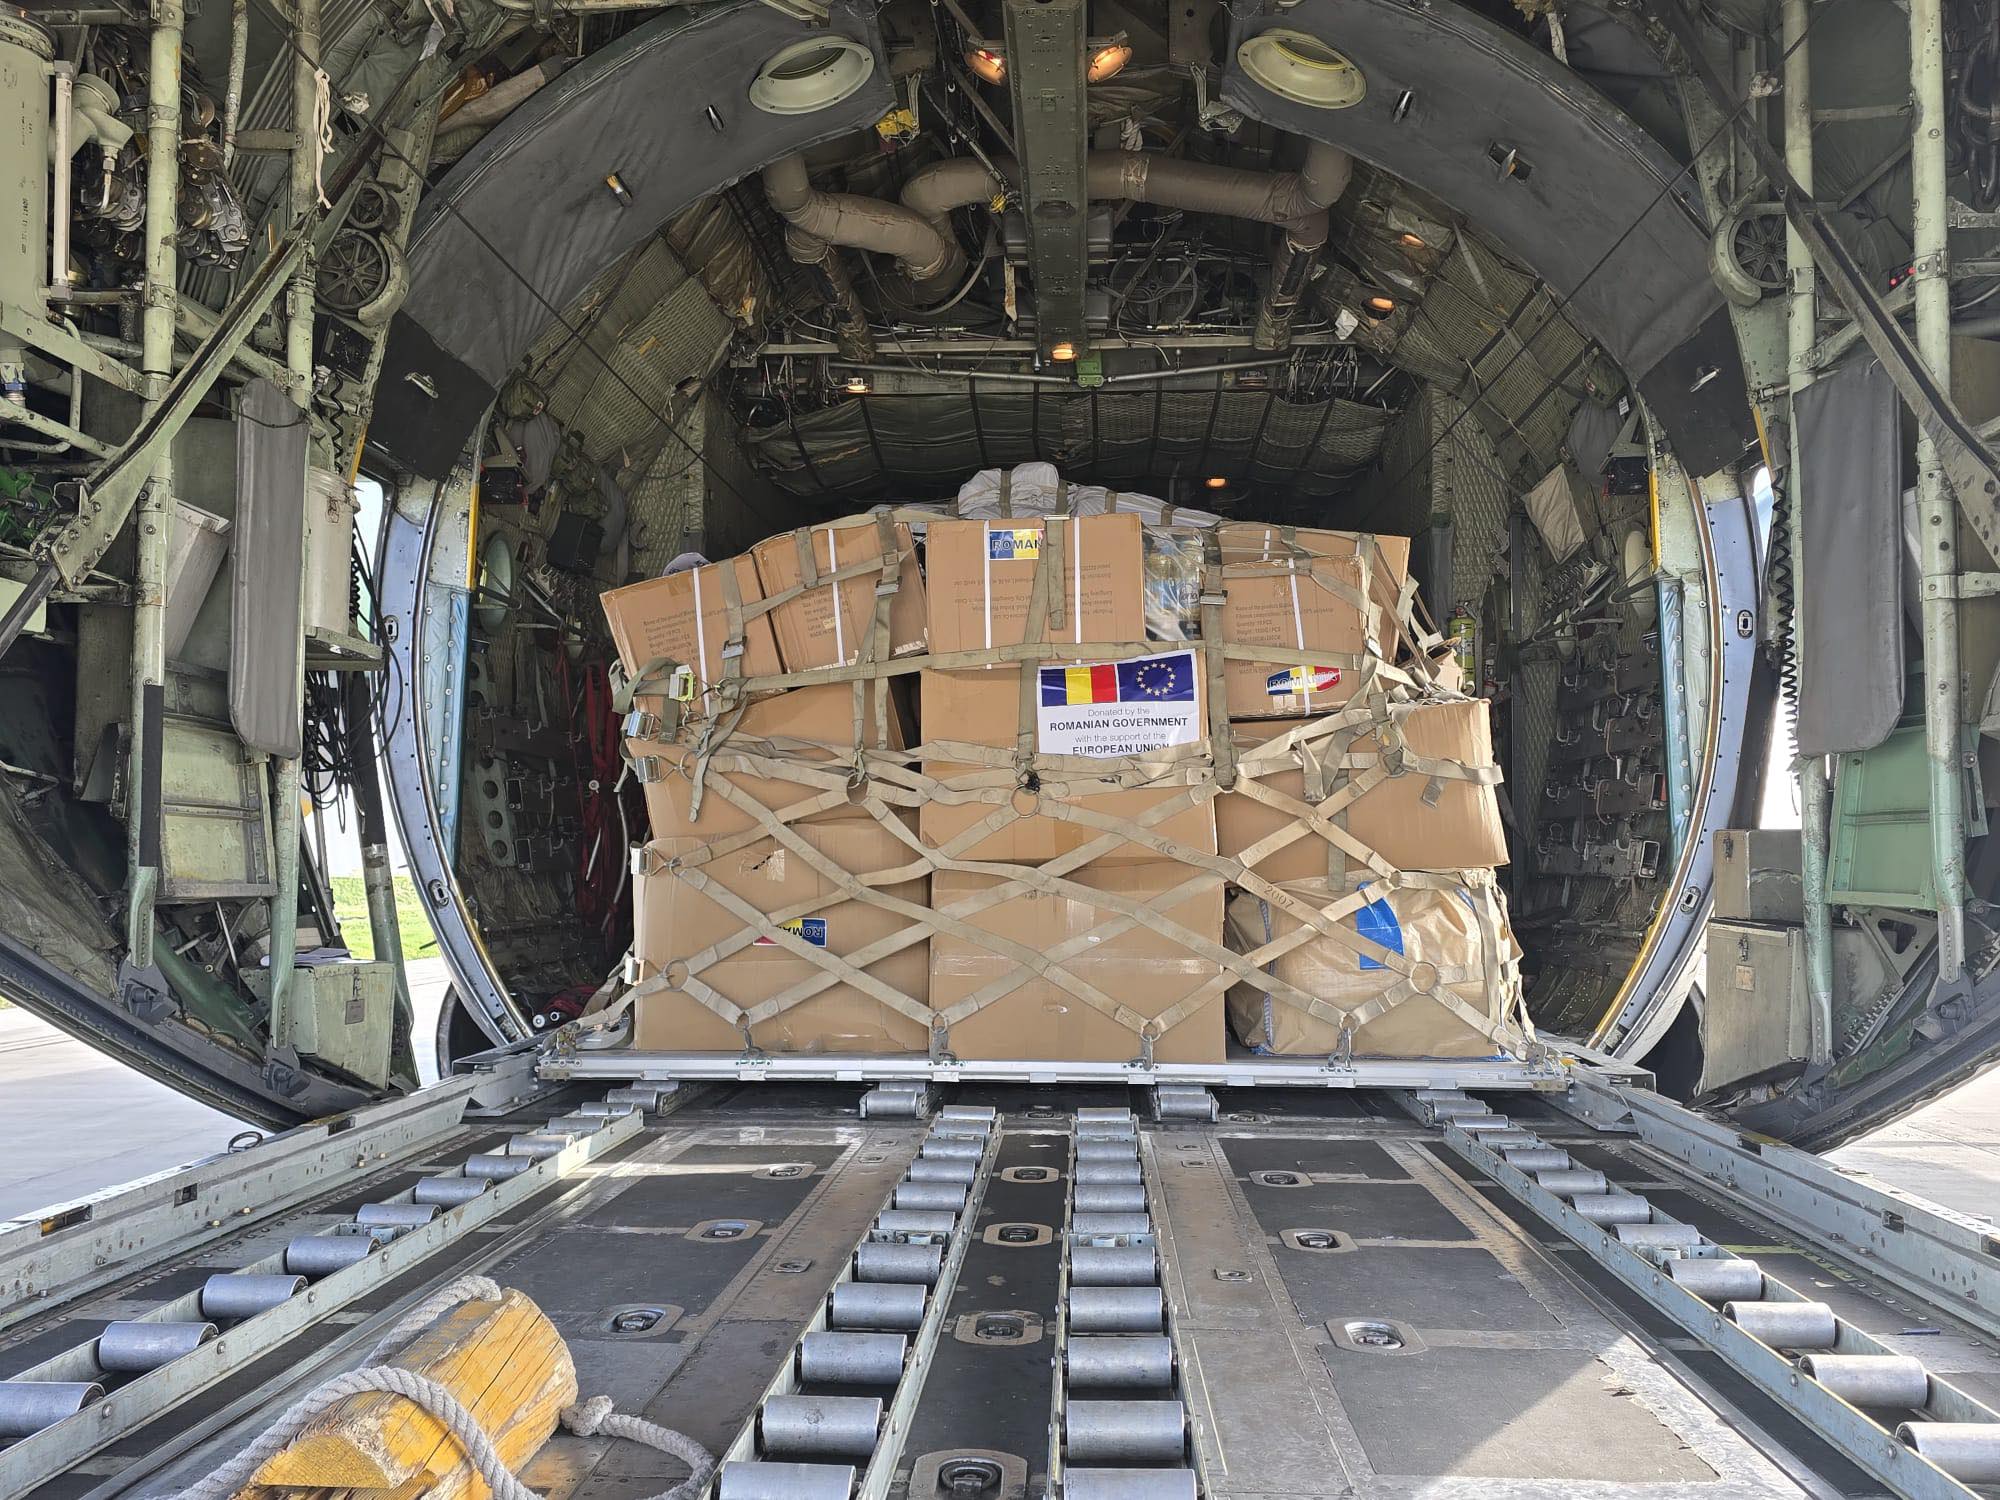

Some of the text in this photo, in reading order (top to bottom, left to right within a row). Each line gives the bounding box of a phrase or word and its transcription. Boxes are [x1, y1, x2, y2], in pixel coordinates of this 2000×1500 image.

[1088, 707, 1150, 717] Donated by the
[1050, 717, 1188, 731] ROMANIAN GOVERNMENT
[1075, 731, 1166, 743] with the support of the
[1073, 744, 1133, 756] EUROPEAN
[1264, 885, 1294, 909] 2007
